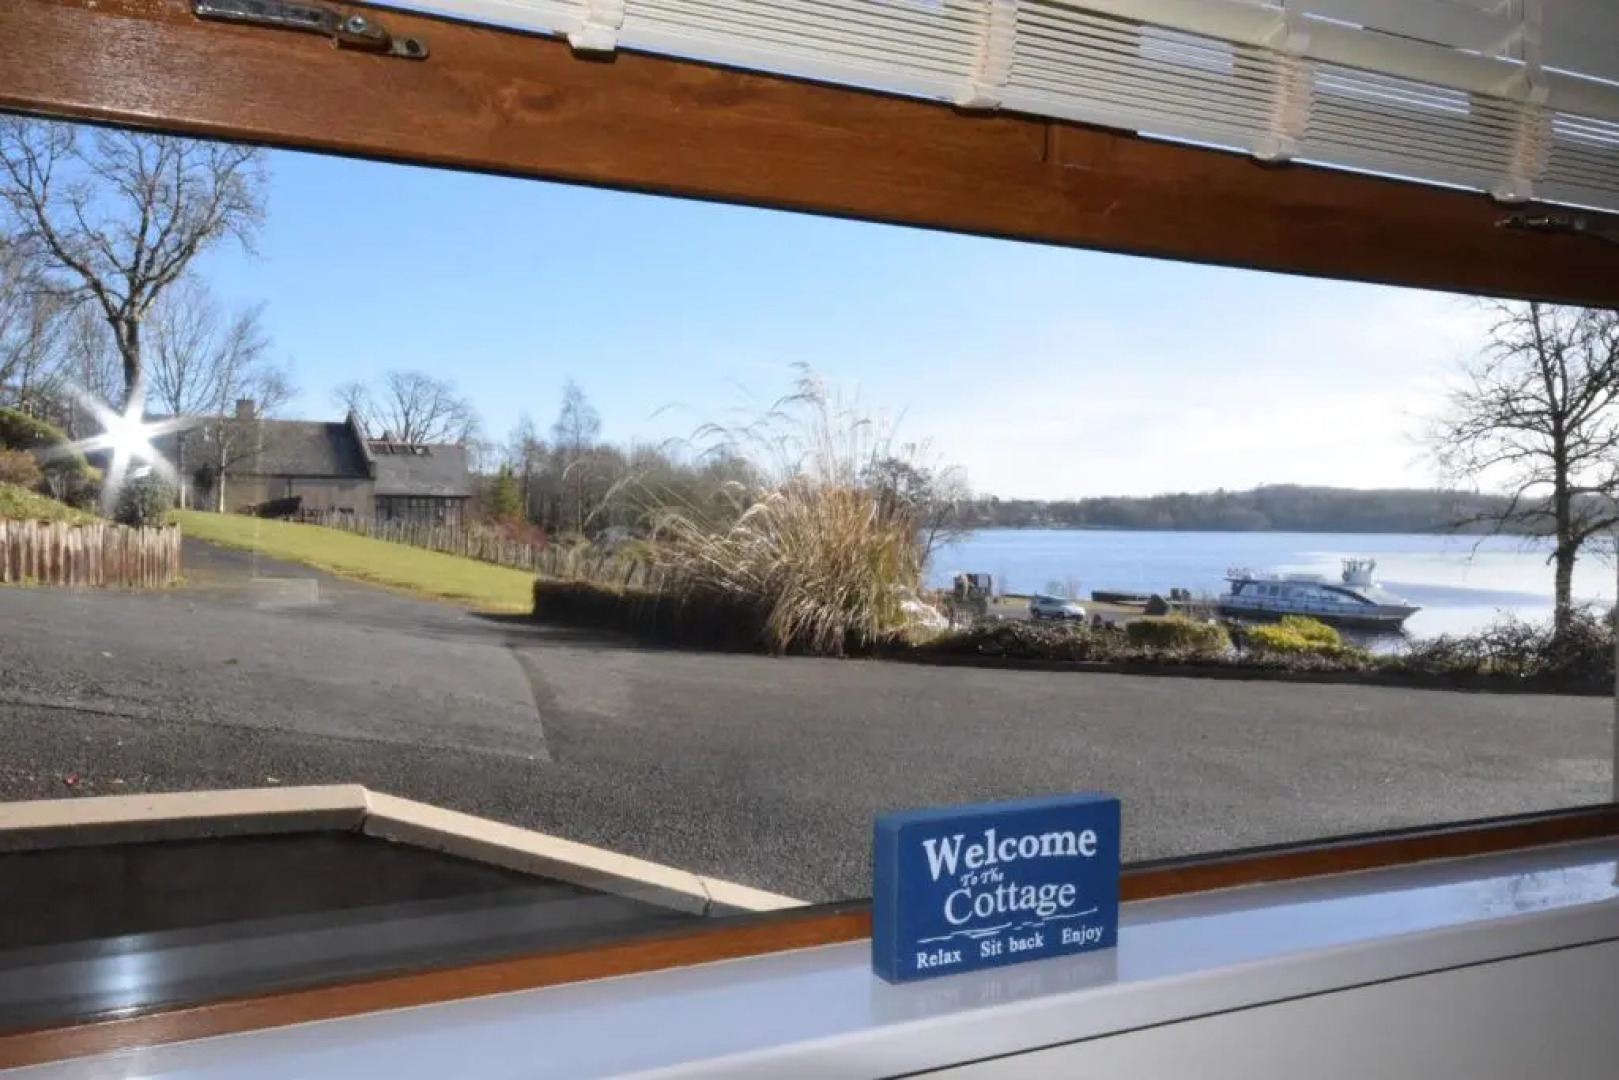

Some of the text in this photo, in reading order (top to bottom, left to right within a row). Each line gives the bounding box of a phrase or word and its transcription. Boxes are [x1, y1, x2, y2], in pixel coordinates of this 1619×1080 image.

[922, 828, 1097, 882] Welcome
[961, 867, 1005, 887] To The
[944, 882, 1076, 925] Cottage
[916, 926, 1103, 969] Relax Sit back Enjoy
